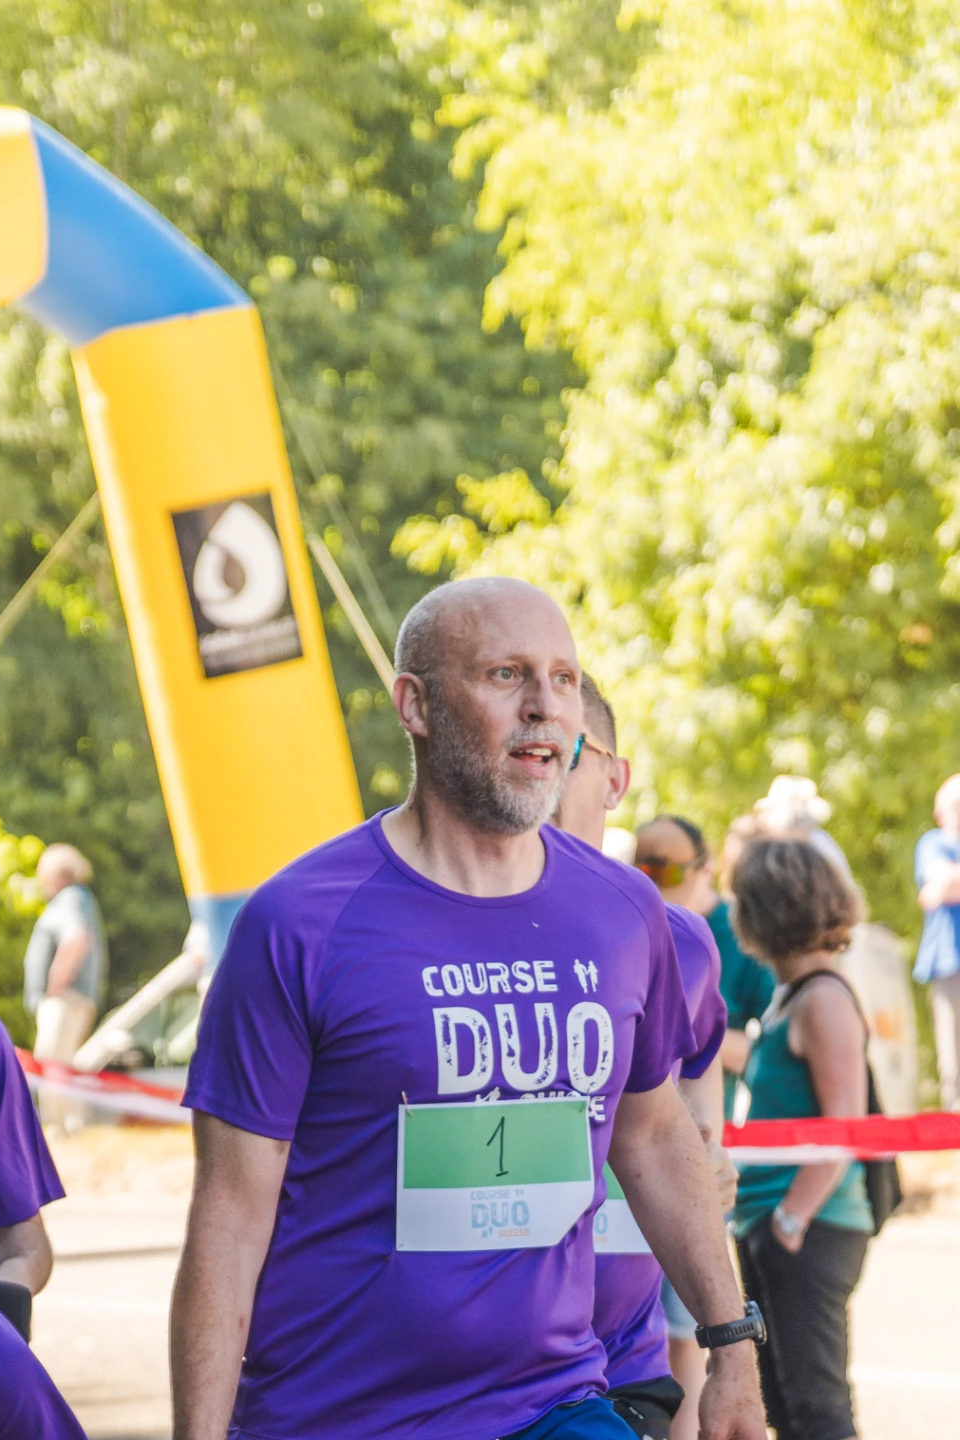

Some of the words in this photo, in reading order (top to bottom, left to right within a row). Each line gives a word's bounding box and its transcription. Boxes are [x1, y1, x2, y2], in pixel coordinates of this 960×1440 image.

[421, 960, 558, 997] COURSE
[432, 1001, 614, 1095] DUO
[486, 1116, 509, 1177] 1
[470, 1189, 511, 1200] COURSE
[471, 1200, 530, 1228] DUO
[497, 1227, 531, 1237] SUISSE
